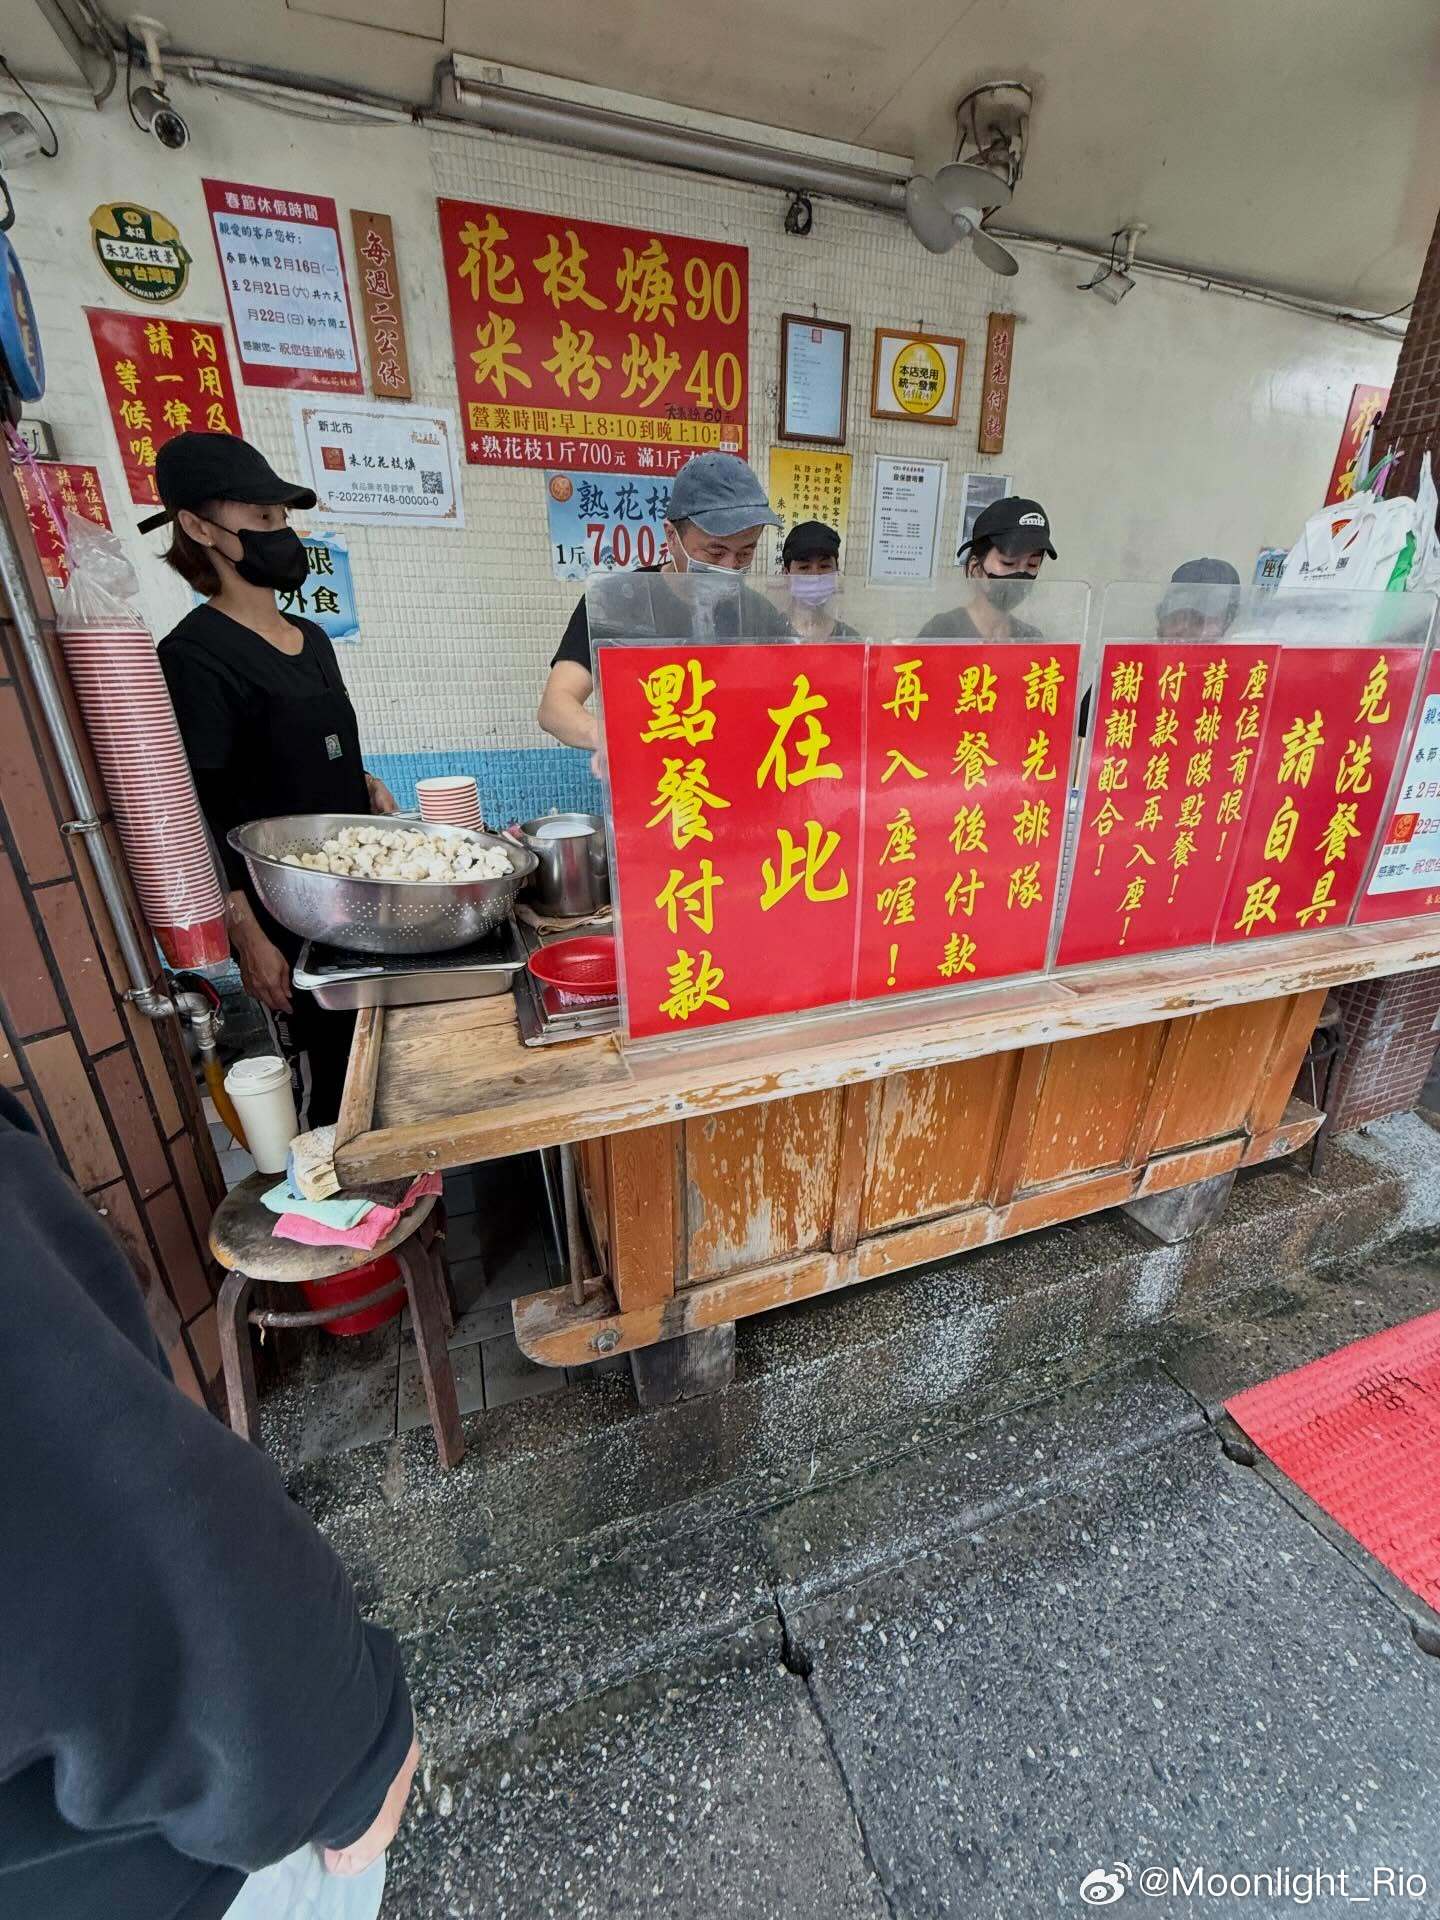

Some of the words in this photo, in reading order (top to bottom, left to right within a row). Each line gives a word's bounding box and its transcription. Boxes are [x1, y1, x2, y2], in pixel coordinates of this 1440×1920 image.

[124, 225, 146, 240] 本店
[124, 280, 155, 299] TAIWAN
[155, 287, 174, 299] PORK
[224, 191, 319, 221] 春節休假時間
[143, 321, 192, 432] 請一律
[361, 231, 405, 388] 每週二公休
[470, 311, 743, 410] 米粉炒40
[898, 378, 938, 391] 統一發票
[900, 365, 939, 380] 本店免用
[984, 331, 1010, 440] 請先付款
[81, 471, 105, 529] 座位有
[318, 420, 353, 434] 新北市
[638, 659, 732, 1021] 點餐付款
[757, 674, 849, 912] 在此
[877, 659, 929, 986] 再入座喔!
[937, 664, 999, 978] 點餐後付款
[1008, 656, 1065, 910] 請先排隊
[1090, 661, 1143, 876] 謝謝配合!
[1116, 661, 1187, 945] 付款後再入座!
[1167, 659, 1229, 904] 請排隊點餐!
[1215, 660, 1269, 862] 座位有限!
[1234, 710, 1325, 935] 請自取
[1296, 655, 1390, 927] 免洗餐具
